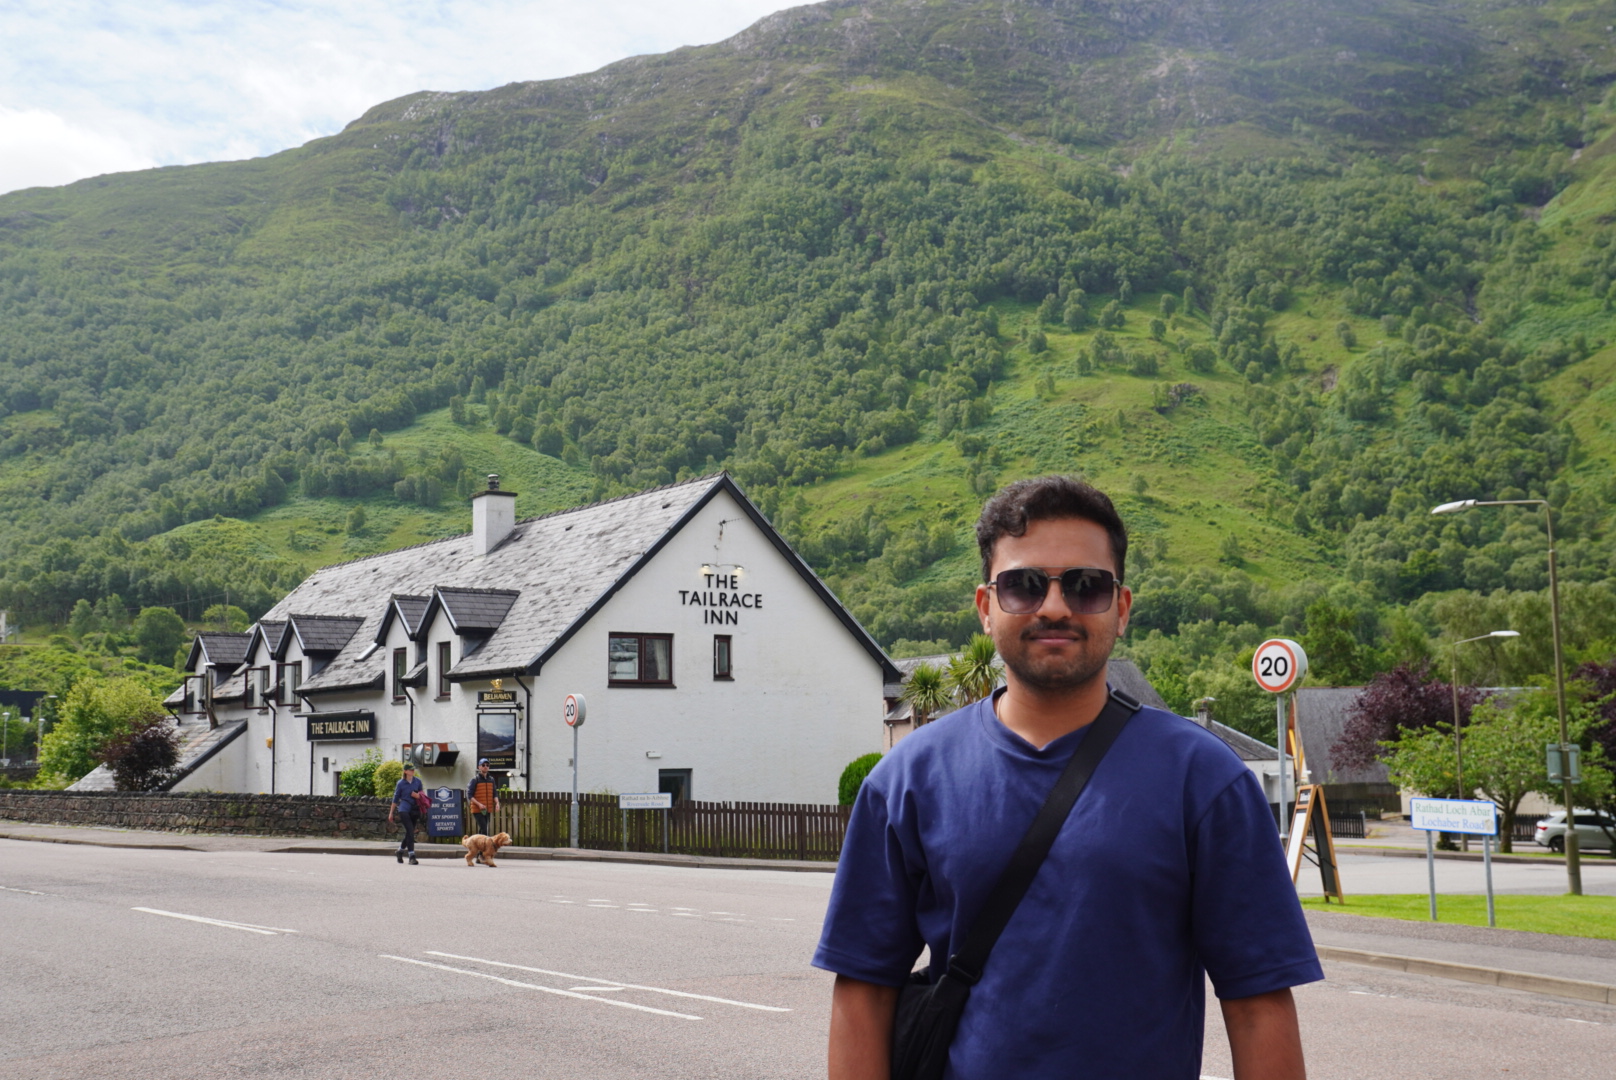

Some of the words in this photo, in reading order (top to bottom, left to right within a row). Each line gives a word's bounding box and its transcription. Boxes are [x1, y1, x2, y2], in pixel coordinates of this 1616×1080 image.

[704, 573, 738, 590] THE
[678, 590, 763, 609] TAILRACE
[704, 609, 738, 625] INN
[1260, 656, 1288, 677] 20
[483, 692, 512, 701] BELHAVEN
[565, 703, 575, 717] 20
[311, 722, 324, 735] THE
[324, 720, 355, 734] TAILRACE
[355, 719, 370, 733] INN
[1415, 802, 1444, 814] Rathad
[1445, 804, 1468, 815] Loch
[1469, 806, 1491, 817] Abar
[1421, 815, 1460, 829] Lochaber
[1462, 818, 1485, 830] Road
